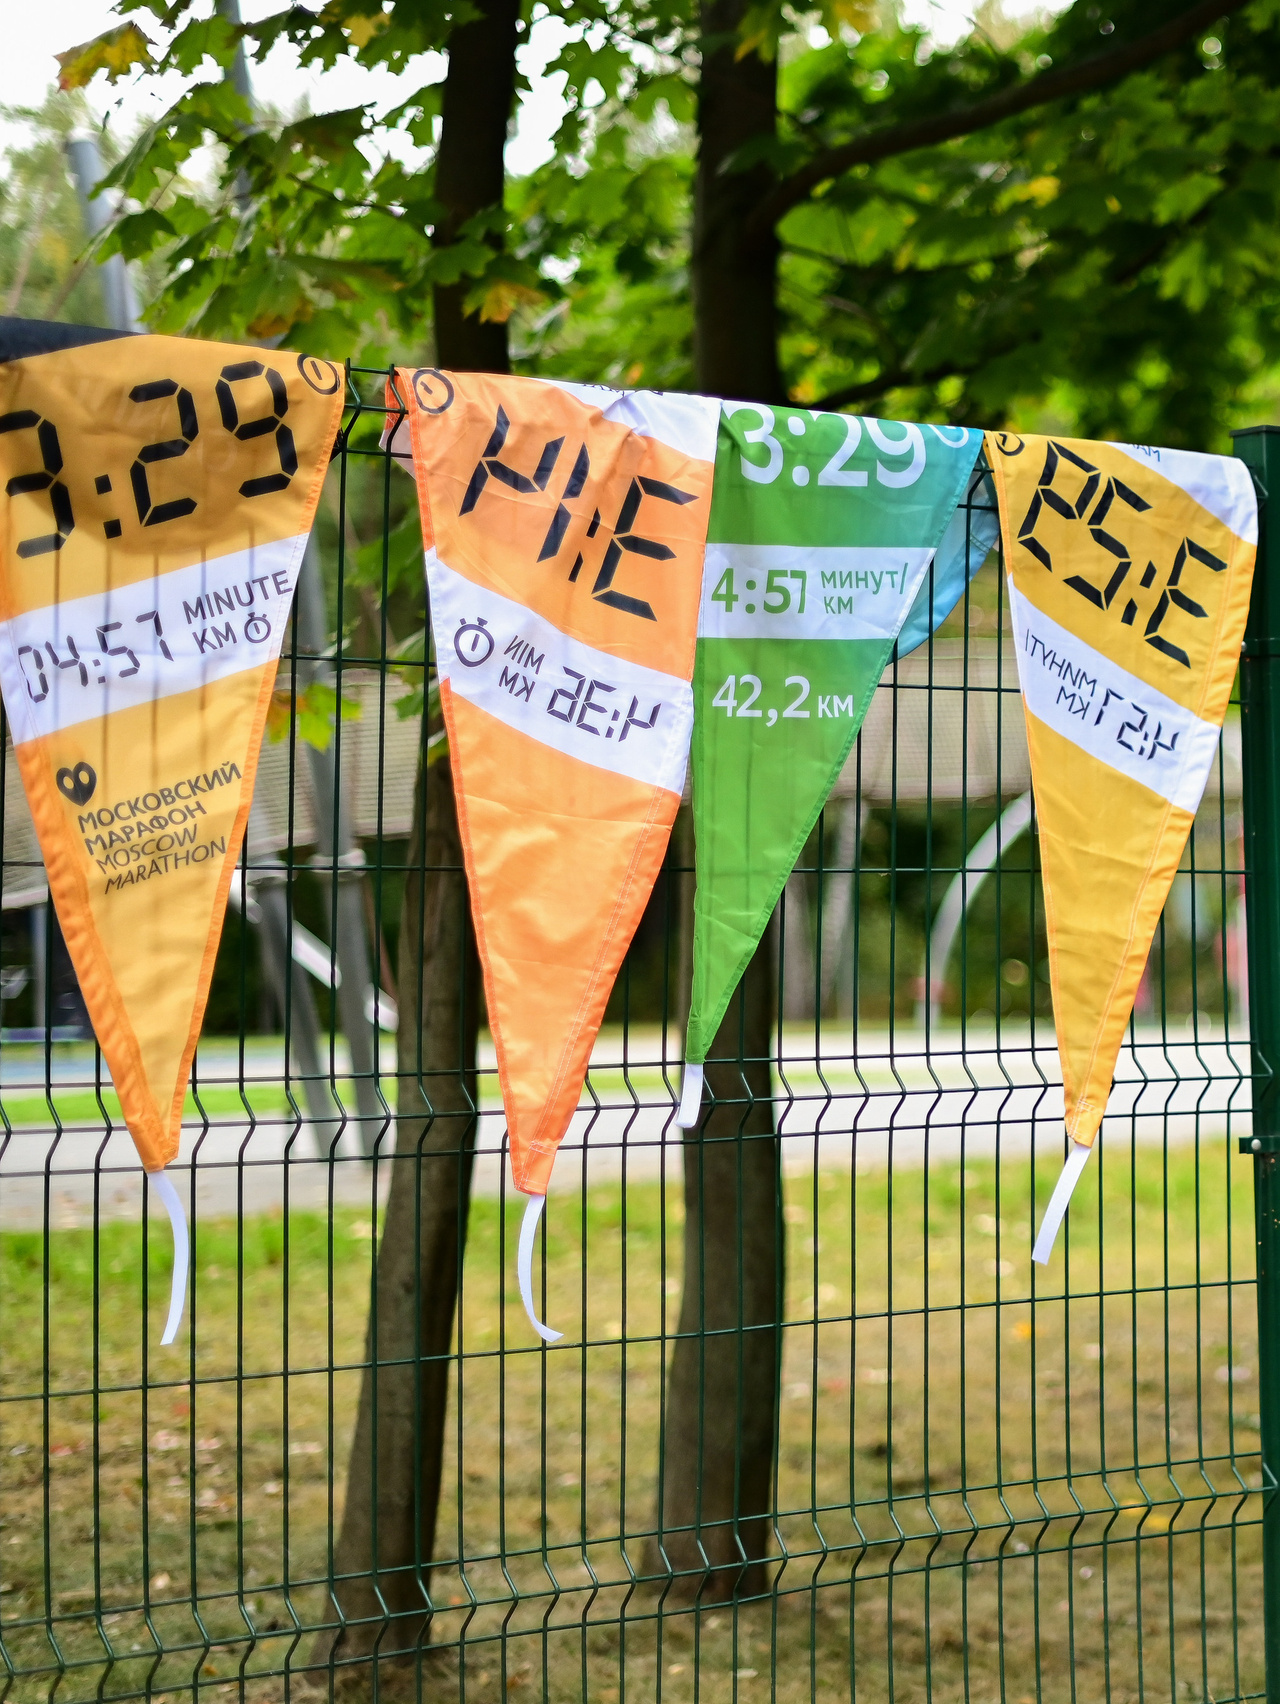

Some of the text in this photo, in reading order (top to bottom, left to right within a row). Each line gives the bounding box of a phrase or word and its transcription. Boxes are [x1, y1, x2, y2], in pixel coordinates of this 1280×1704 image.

[0, 360, 298, 559] 3:29
[722, 403, 927, 488] 3:29
[182, 570, 293, 624] MINUTE
[711, 567, 808, 614] 4:57
[18, 610, 174, 703] 04:57
[192, 622, 237, 654] KM
[712, 674, 811, 727] 42,2
[77, 761, 242, 833] МОСКОВСКИЙ
[84, 801, 207, 855] МАРАФОН
[96, 824, 198, 875] MOSCOW
[104, 836, 227, 894] MARATHON
